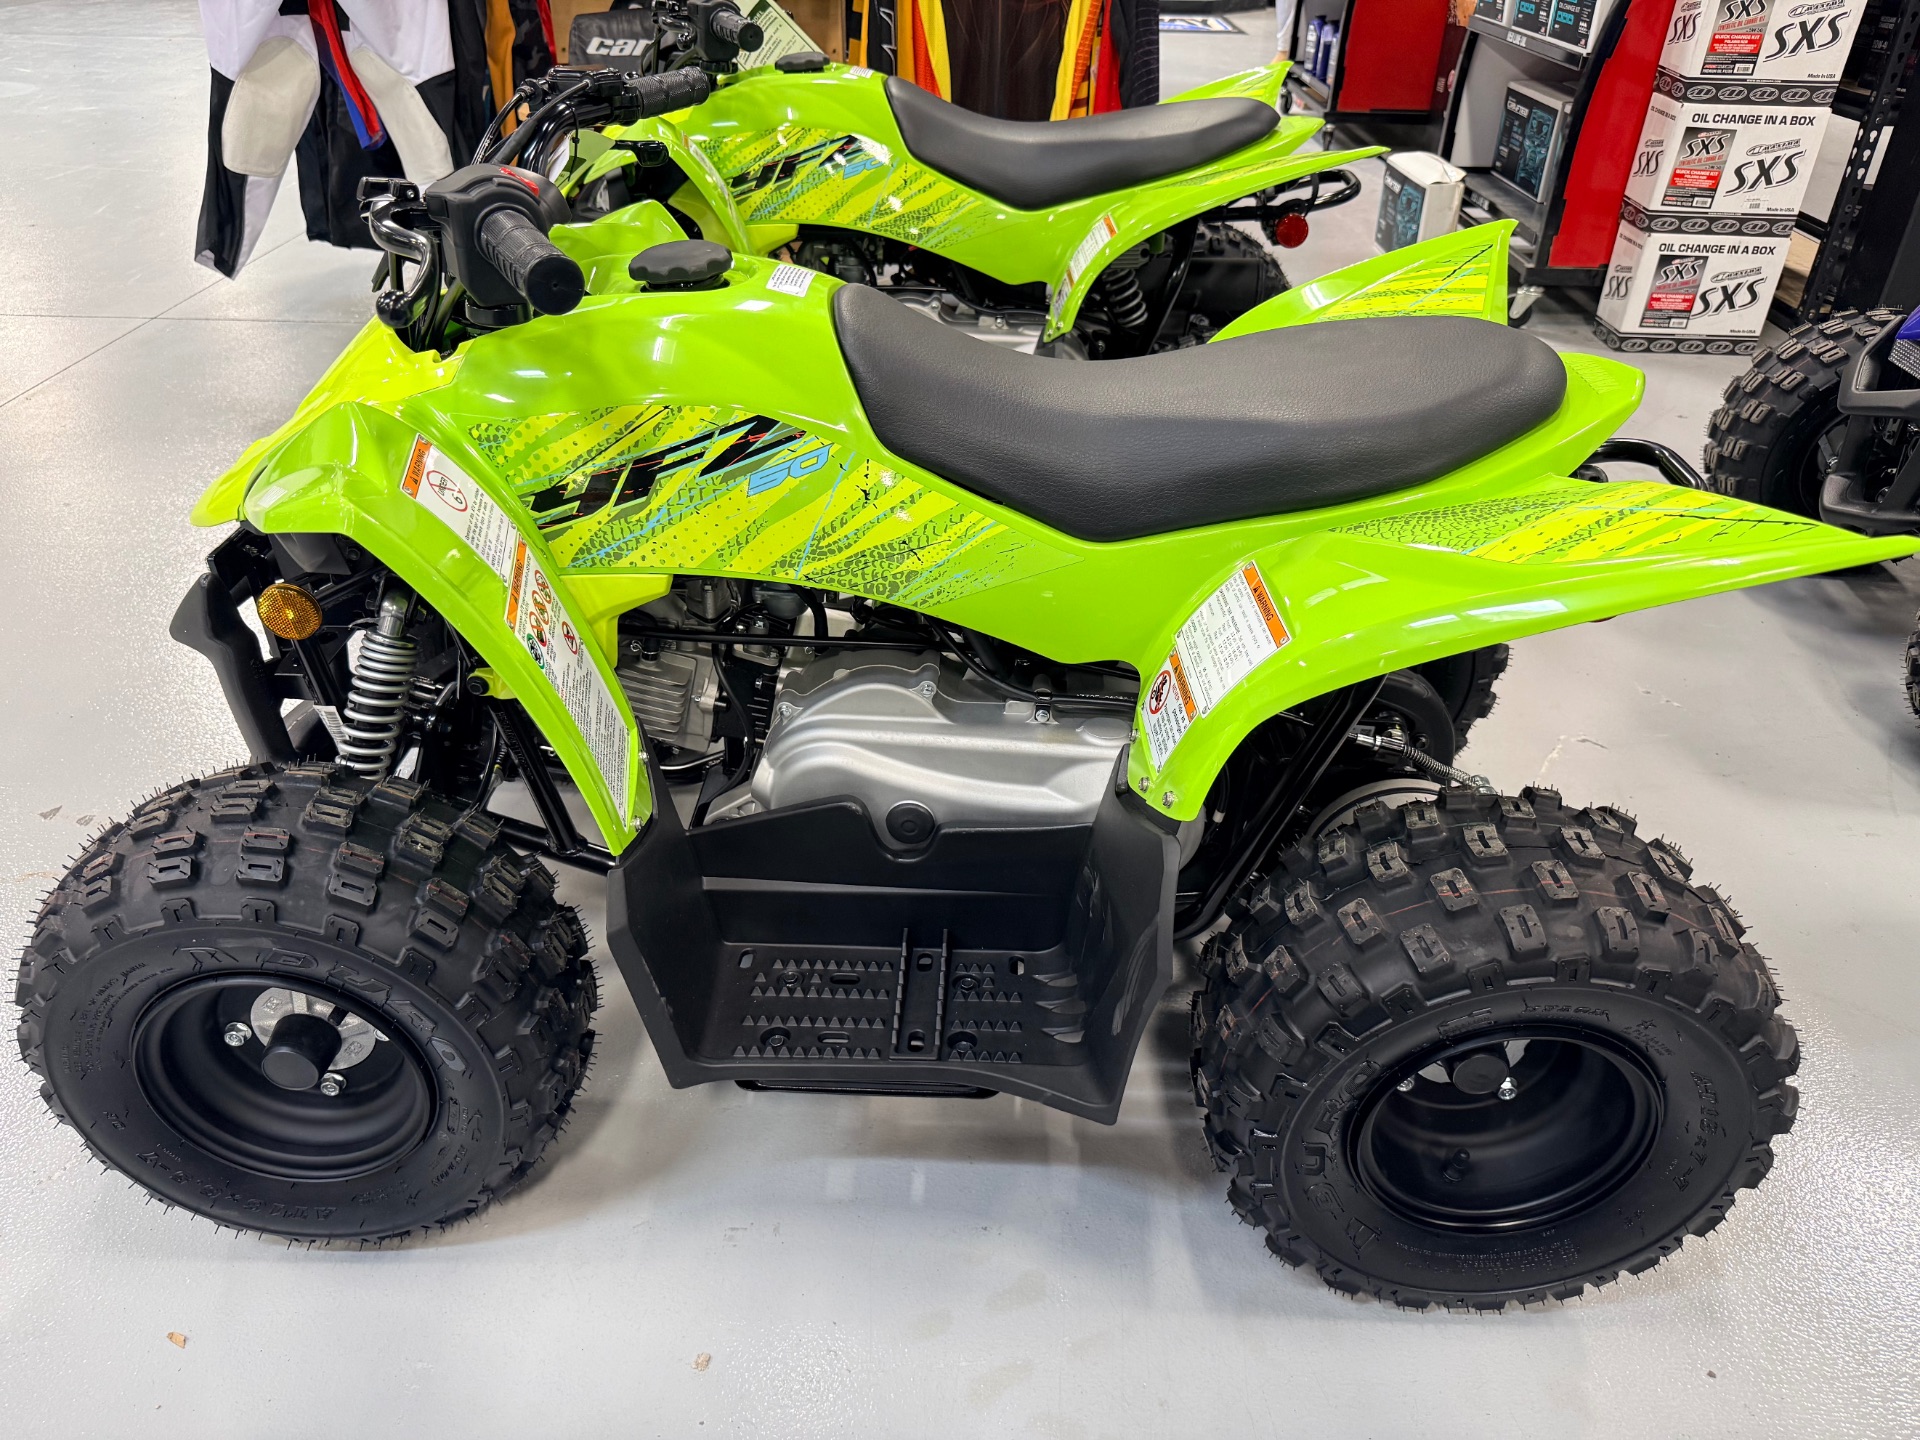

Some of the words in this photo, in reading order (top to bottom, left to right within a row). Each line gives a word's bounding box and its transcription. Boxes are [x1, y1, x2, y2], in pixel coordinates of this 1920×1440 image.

[1668, 11, 1702, 45] SXS
[1763, 9, 1851, 62] SXS
[1691, 112, 1710, 124] OIL
[1712, 114, 1762, 125] CHANGE
[1764, 114, 1778, 125] IN
[1779, 115, 1791, 125] A
[1792, 115, 1816, 126] BOX
[1681, 133, 1731, 159] SXS
[1632, 150, 1664, 177] SXS
[1723, 149, 1807, 197] SXS
[1658, 243, 1676, 252] OIL
[1678, 244, 1725, 254] CHANGE
[1726, 245, 1740, 254] IN
[1741, 246, 1751, 255] A
[1751, 246, 1776, 255] BOX
[1604, 275, 1633, 300] SXS
[1656, 260, 1704, 285] SXS
[1690, 276, 1768, 320] SXS
[412, 448, 426, 477] WARNING
[747, 444, 831, 497] 50
[449, 493, 464, 504] 6
[513, 559, 523, 594] WARNING
[1256, 590, 1274, 621] WARNING
[1176, 671, 1190, 705] WARNING
[259, 946, 469, 1072] DURO
[1301, 1059, 1383, 1259] DURO
